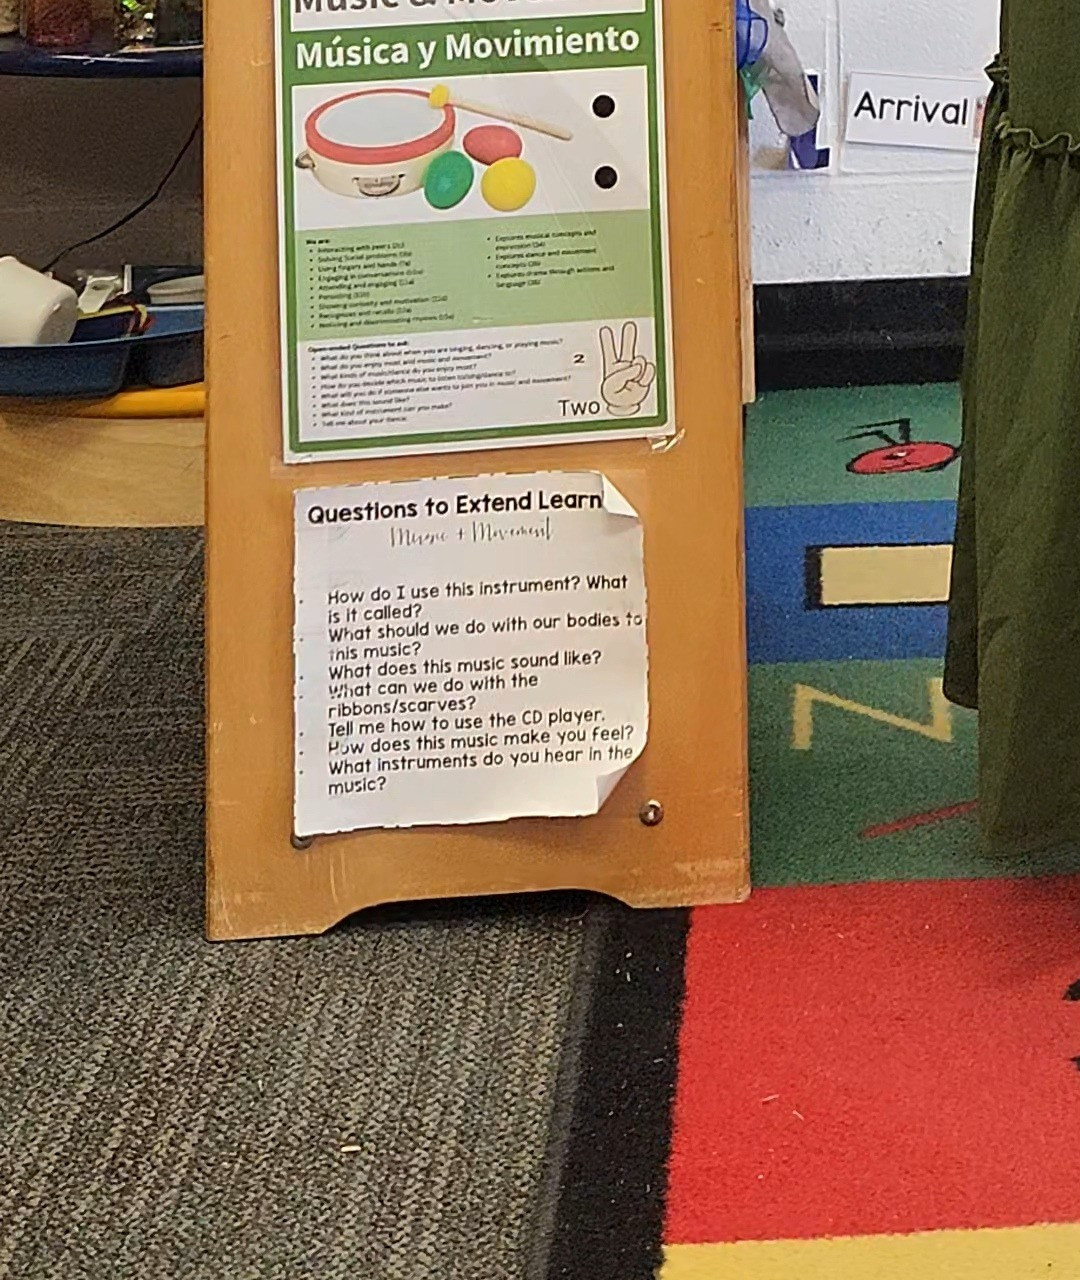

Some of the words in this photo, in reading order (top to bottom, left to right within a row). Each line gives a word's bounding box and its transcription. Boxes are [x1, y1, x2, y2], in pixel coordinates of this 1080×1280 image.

[295, 34, 409, 70] Música
[418, 39, 437, 69] y
[446, 26, 640, 61] Movimiento
[853, 90, 968, 125] Arrival
[573, 353, 585, 364] 2
[558, 400, 601, 417] Two
[308, 502, 418, 524] Questions
[425, 498, 448, 517] to
[457, 490, 532, 514] Extend
[328, 590, 365, 605] How
[371, 587, 391, 602] do
[397, 585, 405, 600] I
[411, 587, 439, 599] use
[446, 582, 474, 597] this
[480, 576, 581, 596] instrument?
[586, 574, 628, 590] What
[328, 610, 341, 624] is
[347, 607, 358, 622] it
[364, 603, 423, 621] called?
[328, 626, 371, 643] What
[378, 622, 430, 639] should
[436, 624, 460, 635] we
[466, 620, 486, 634] do
[492, 617, 527, 633] with
[533, 618, 561, 629] our
[567, 612, 620, 628] bodies
[626, 611, 643, 626] to
[328, 664, 371, 680] What
[378, 661, 417, 677] does
[423, 659, 452, 674] this
[457, 656, 505, 673] music
[511, 651, 559, 669] sound
[564, 649, 602, 666] like?
[364, 641, 422, 659] music?
[328, 683, 372, 699] What
[378, 684, 408, 695] can
[414, 682, 438, 694] we
[444, 678, 464, 693] do
[470, 675, 506, 691] with
[511, 673, 539, 688] the
[328, 696, 477, 719] ribbons/scarves?
[328, 723, 354, 738] Tell
[358, 724, 385, 734] me
[391, 718, 426, 733] how
[432, 717, 450, 731] to
[454, 719, 483, 730] use
[489, 713, 516, 728] the
[521, 710, 543, 725] CD
[549, 707, 606, 727] player.
[328, 741, 365, 756] How
[371, 738, 411, 753] does
[417, 736, 446, 751] this
[451, 732, 498, 749] music
[503, 729, 551, 745] make
[557, 730, 586, 745] you
[592, 725, 635, 742] feel?
[328, 759, 372, 775] What
[378, 754, 477, 772] instruments
[483, 751, 504, 766] do
[510, 752, 539, 768] you
[543, 748, 584, 765] hear
[589, 746, 602, 761] in
[608, 746, 633, 760] the
[328, 776, 387, 795] music?
